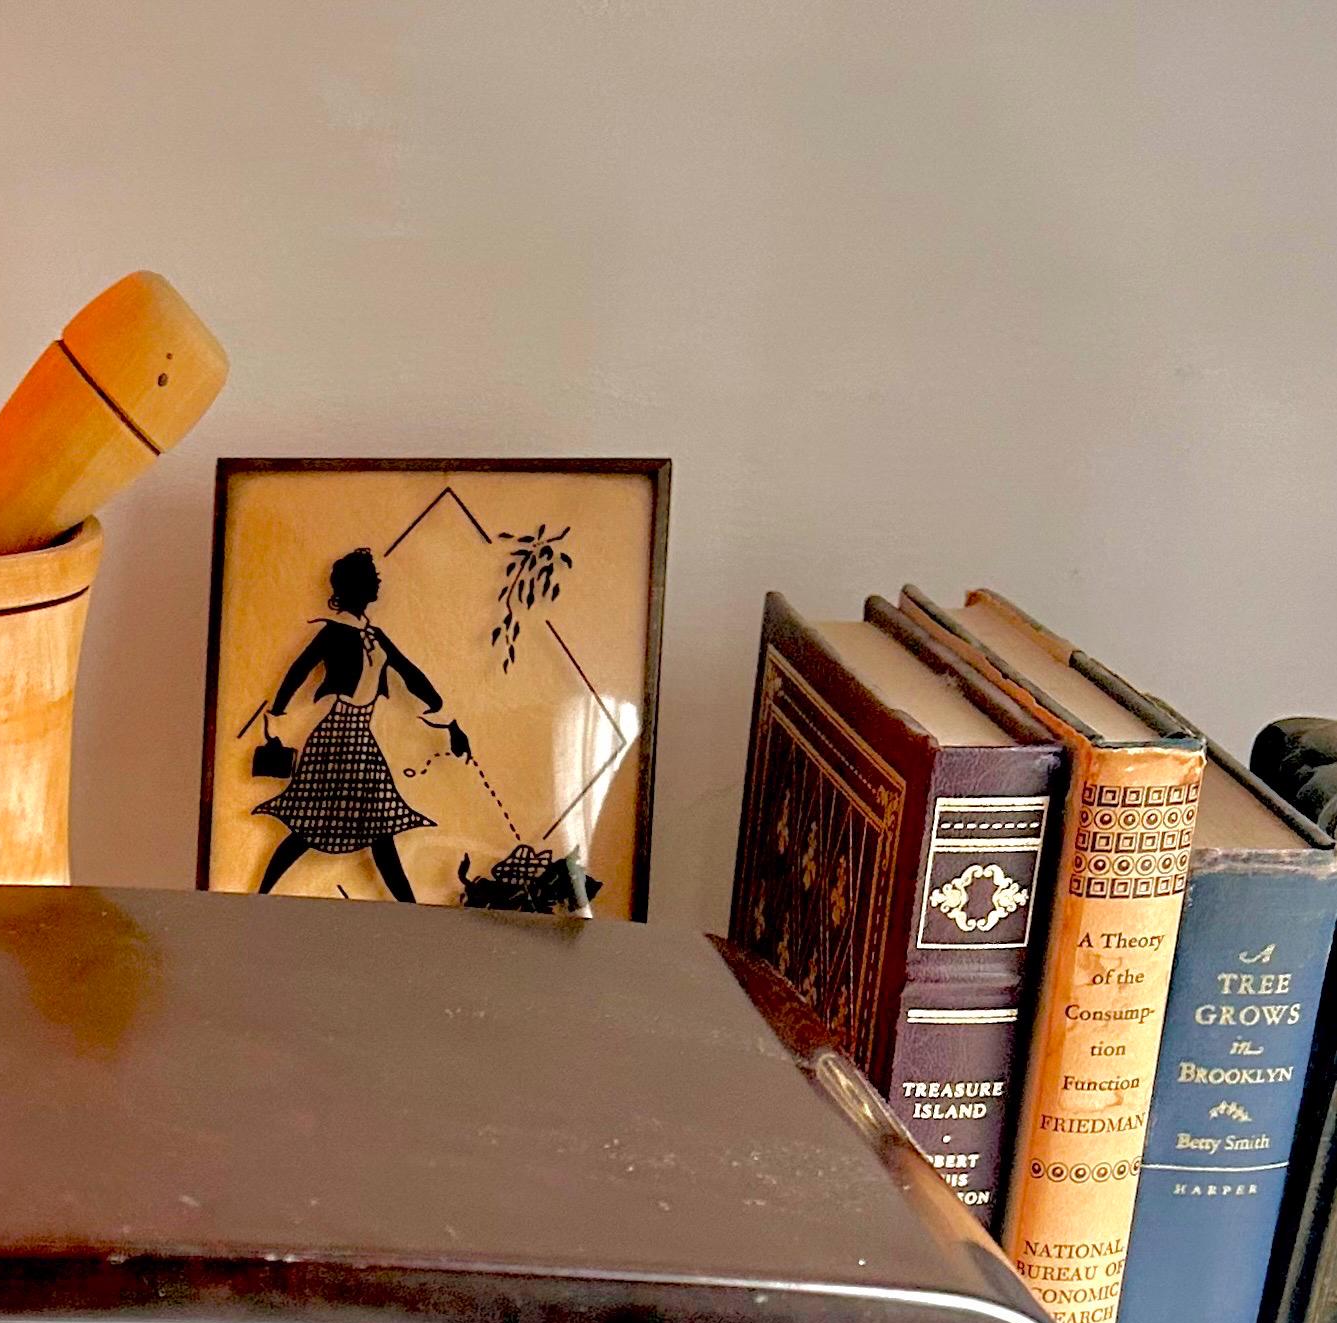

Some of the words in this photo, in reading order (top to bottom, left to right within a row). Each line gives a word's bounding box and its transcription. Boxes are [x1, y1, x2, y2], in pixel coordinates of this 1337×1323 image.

[1077, 932, 1092, 948] A
[1100, 932, 1165, 951] Theory
[1239, 943, 1276, 964] A
[1092, 969, 1116, 985] of
[1117, 970, 1144, 985] the
[1217, 973, 1292, 995] TREE
[1065, 1004, 1155, 1024] Consump-
[1195, 1003, 1301, 1026] GROWS
[1091, 1042, 1126, 1056] tion
[1229, 1035, 1264, 1055] in
[1177, 1061, 1294, 1084] BROOKLYN
[903, 1081, 1004, 1098] TREASURE
[1061, 1075, 1140, 1091] Function
[913, 1103, 987, 1119] ISLAND
[1040, 1112, 1145, 1134] FRIEDMAN
[1175, 1133, 1221, 1155] Betty
[1224, 1134, 1270, 1150] Smith
[927, 1153, 980, 1168] BERT
[1173, 1184, 1258, 1195] HARPER
[1024, 1239, 1124, 1259] NATIONAL
[1016, 1260, 1098, 1281] BUREAU
[1105, 1259, 1125, 1277] OF
[1031, 1282, 1119, 1304] ONOMIC
